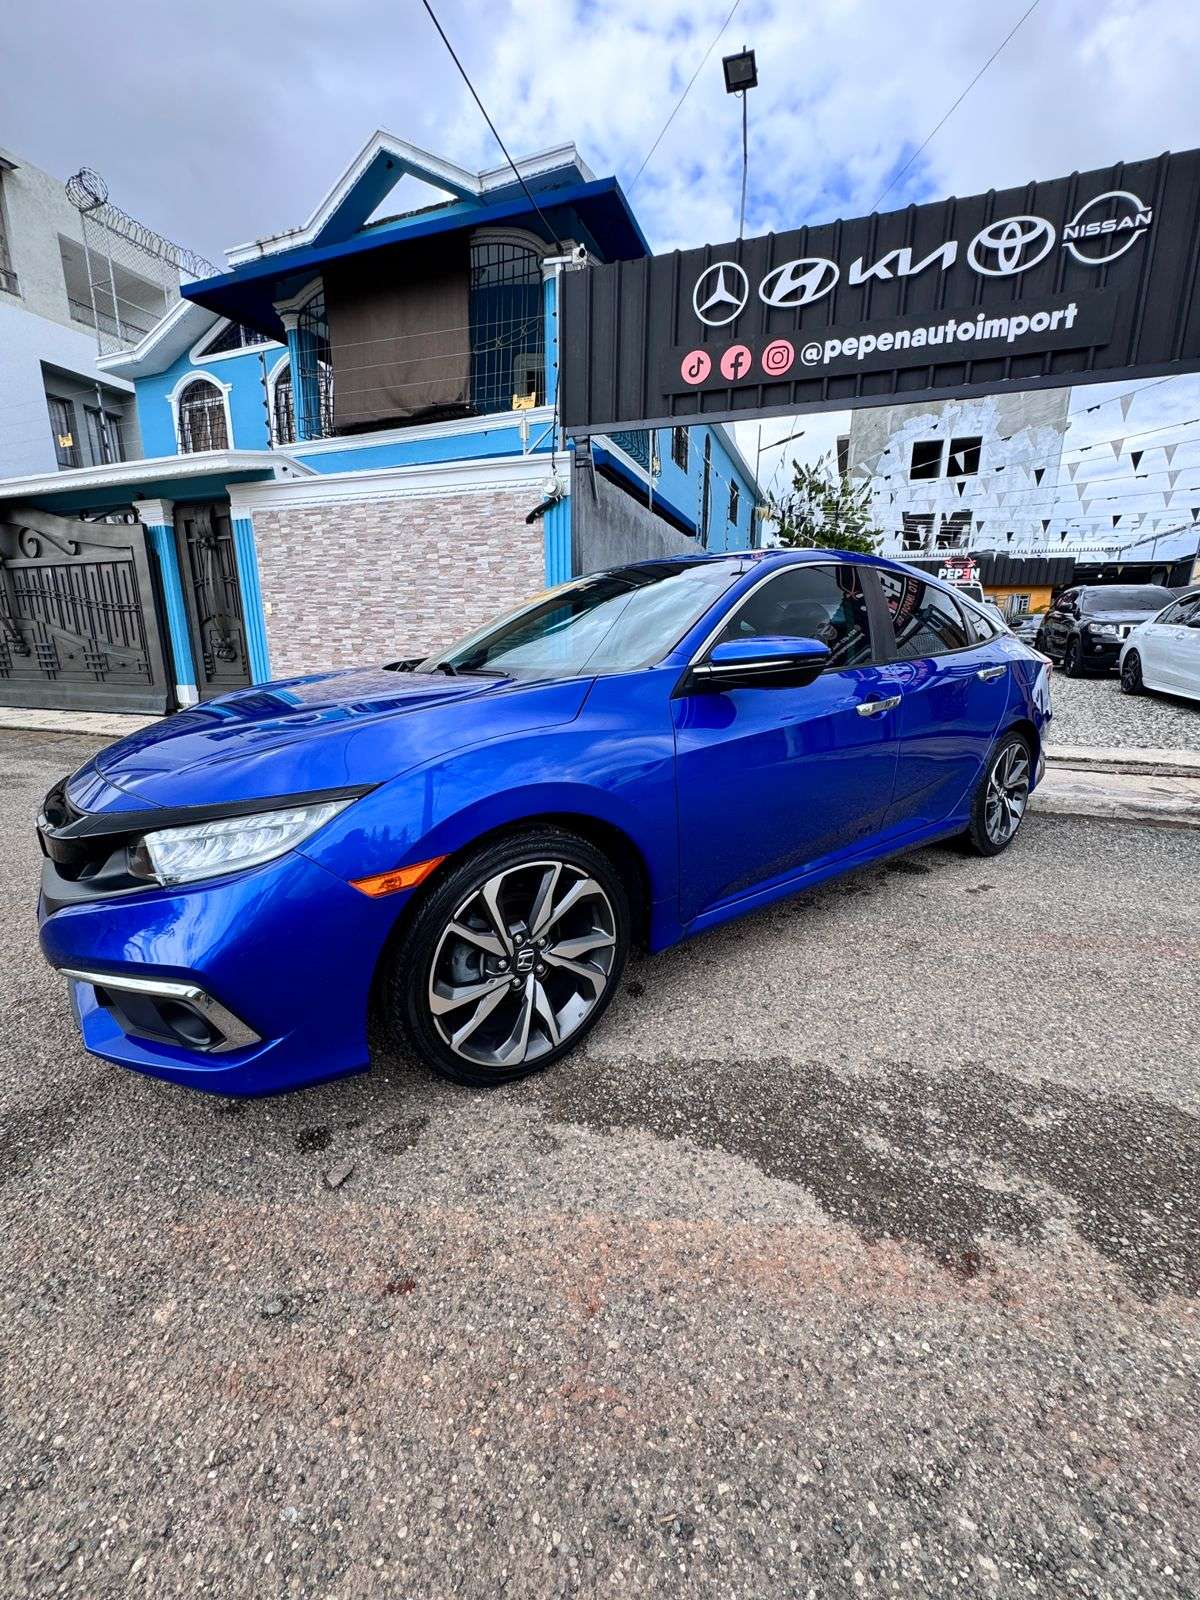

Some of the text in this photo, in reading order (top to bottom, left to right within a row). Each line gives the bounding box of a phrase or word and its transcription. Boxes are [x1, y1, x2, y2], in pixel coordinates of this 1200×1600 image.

[1063, 210, 1152, 240] NISSAN
[849, 241, 958, 285] KIA
[800, 303, 1078, 366] @pepenautoimport
